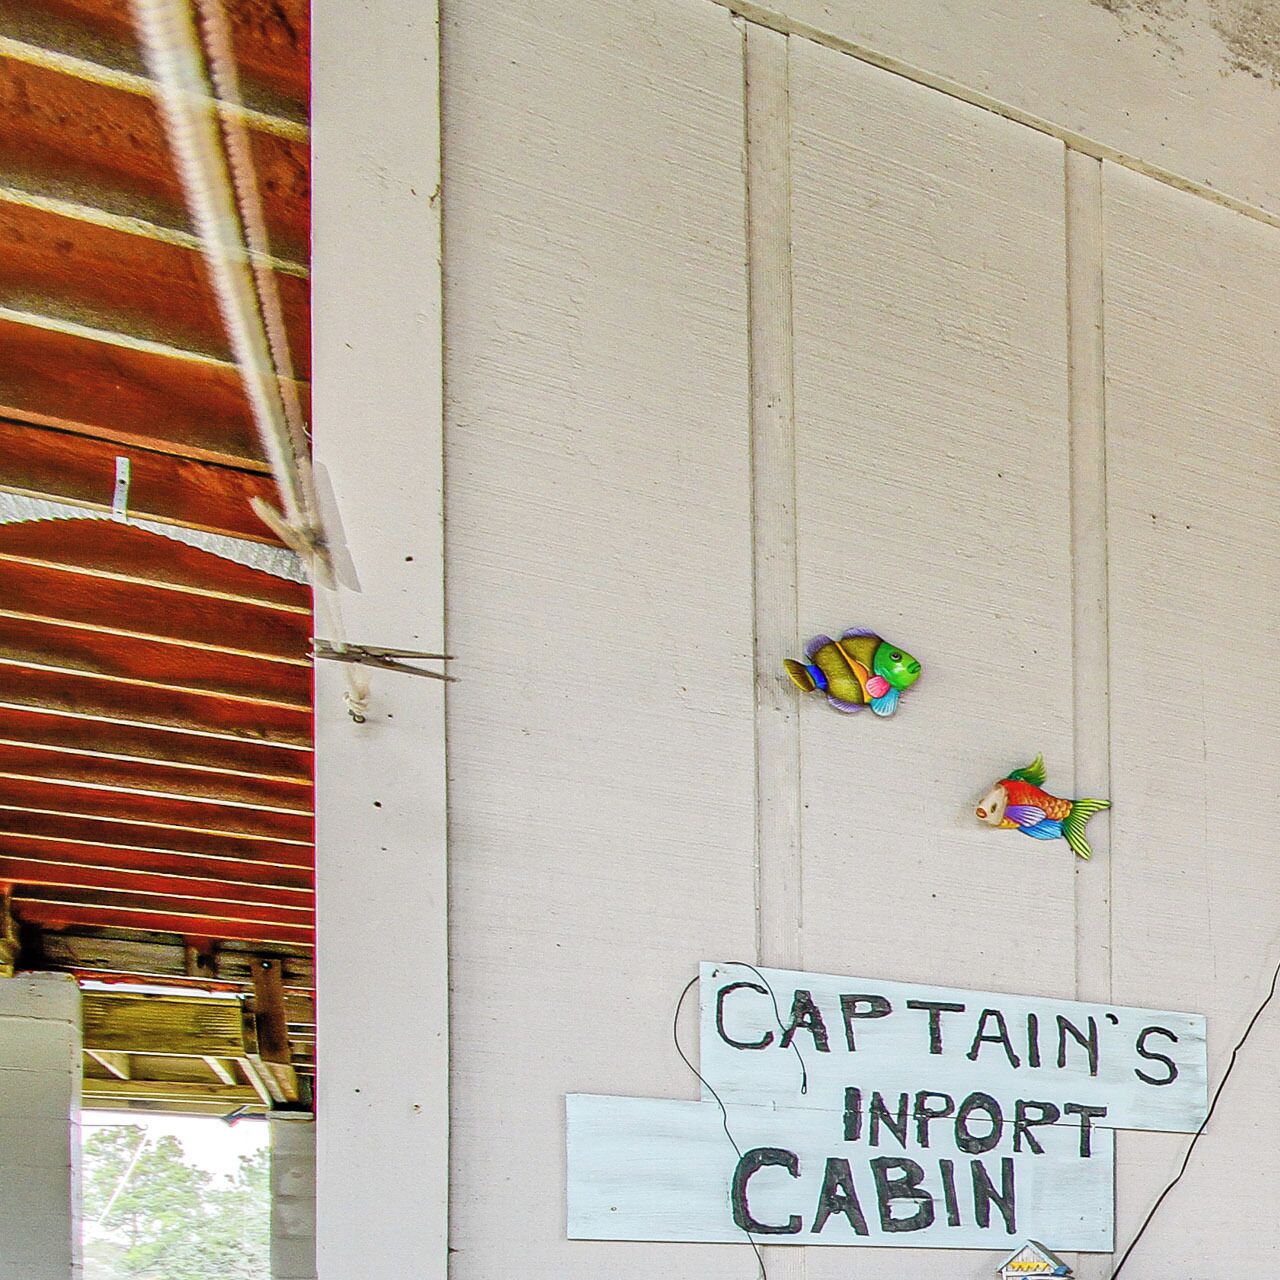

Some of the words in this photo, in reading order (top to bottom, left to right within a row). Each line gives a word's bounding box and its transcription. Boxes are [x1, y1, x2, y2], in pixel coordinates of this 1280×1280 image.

[716, 982, 1179, 1086] CAPTAIN'S
[843, 1086, 1107, 1158] INPORT
[732, 1147, 1017, 1236] CABIN
